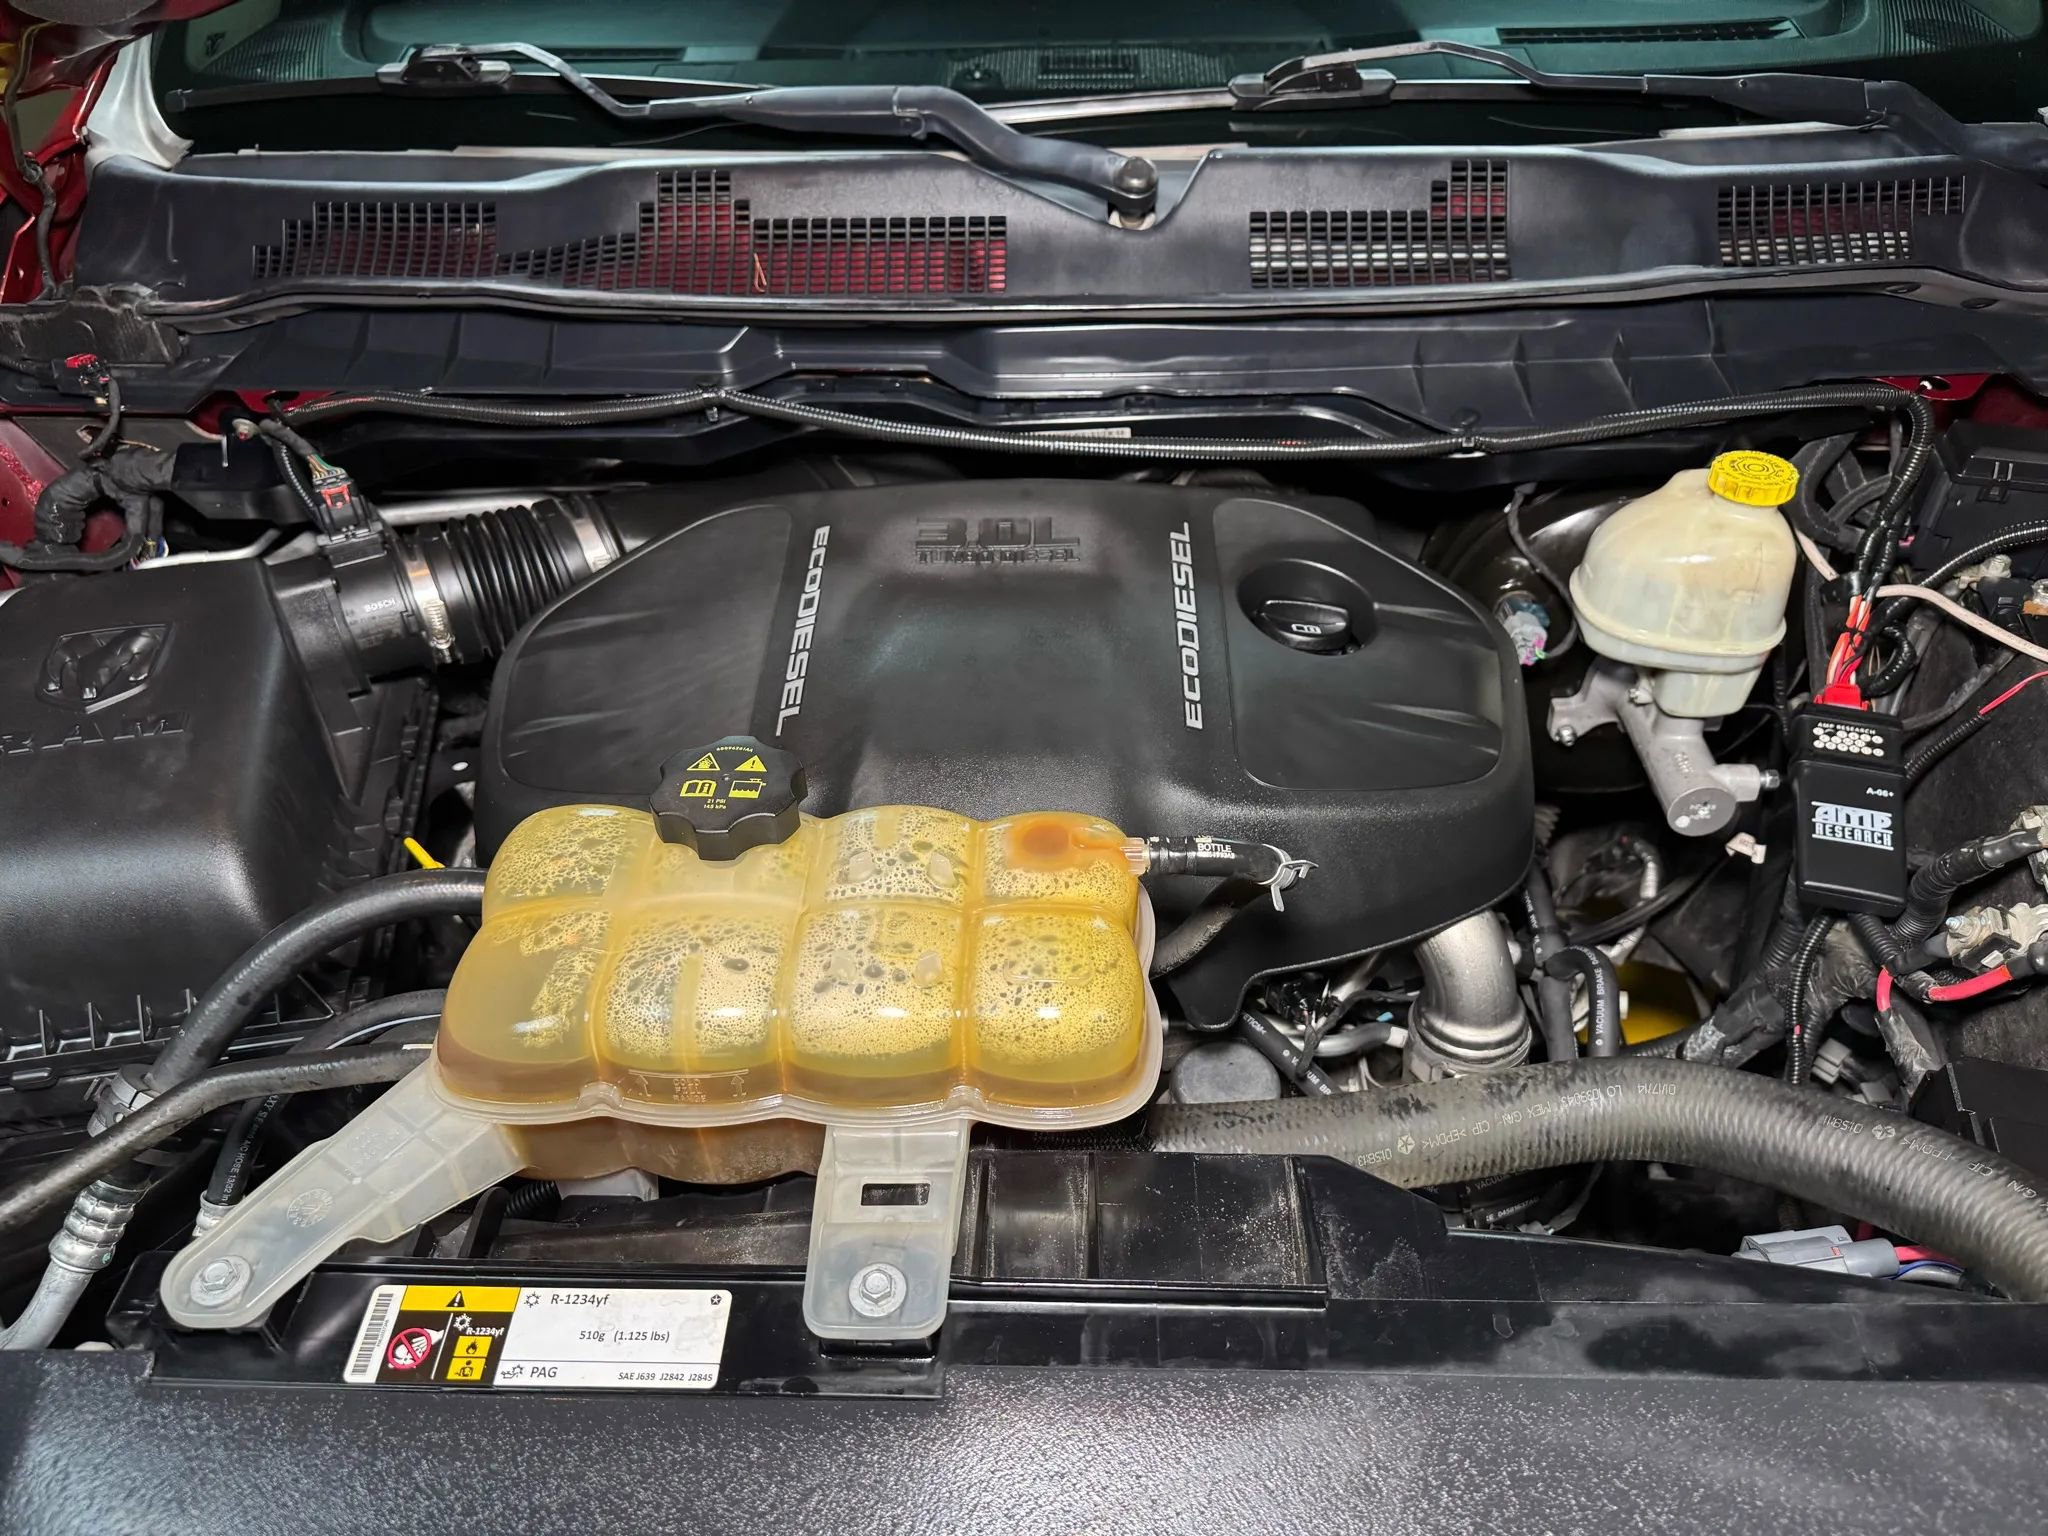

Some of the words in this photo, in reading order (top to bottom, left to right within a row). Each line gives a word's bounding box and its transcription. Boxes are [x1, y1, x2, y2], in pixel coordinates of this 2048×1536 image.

[365, 597, 396, 612] BOSCH
[775, 525, 831, 737] ECODIESEL
[1169, 521, 1204, 730] ECODIESEL
[1836, 724, 1876, 735] RESEARCH
[1815, 822, 1892, 847] RESEARCH
[1197, 843, 1232, 853] BOTTLE
[1594, 968, 1605, 995] BRAKE
[1595, 1000, 1605, 1036] VACUUM
[231, 1152, 246, 1174] HOSE
[223, 1174, 237, 1194] 13/32
[551, 1294, 610, 1307] R-1234yf
[465, 1327, 505, 1337] R-1234yf
[579, 1330, 606, 1342] 510g
[613, 1330, 648, 1343] (1.125
[650, 1331, 670, 1343] lbs)
[530, 1366, 558, 1378] PAG
[618, 1372, 637, 1380] SAE
[636, 1373, 656, 1381] J639
